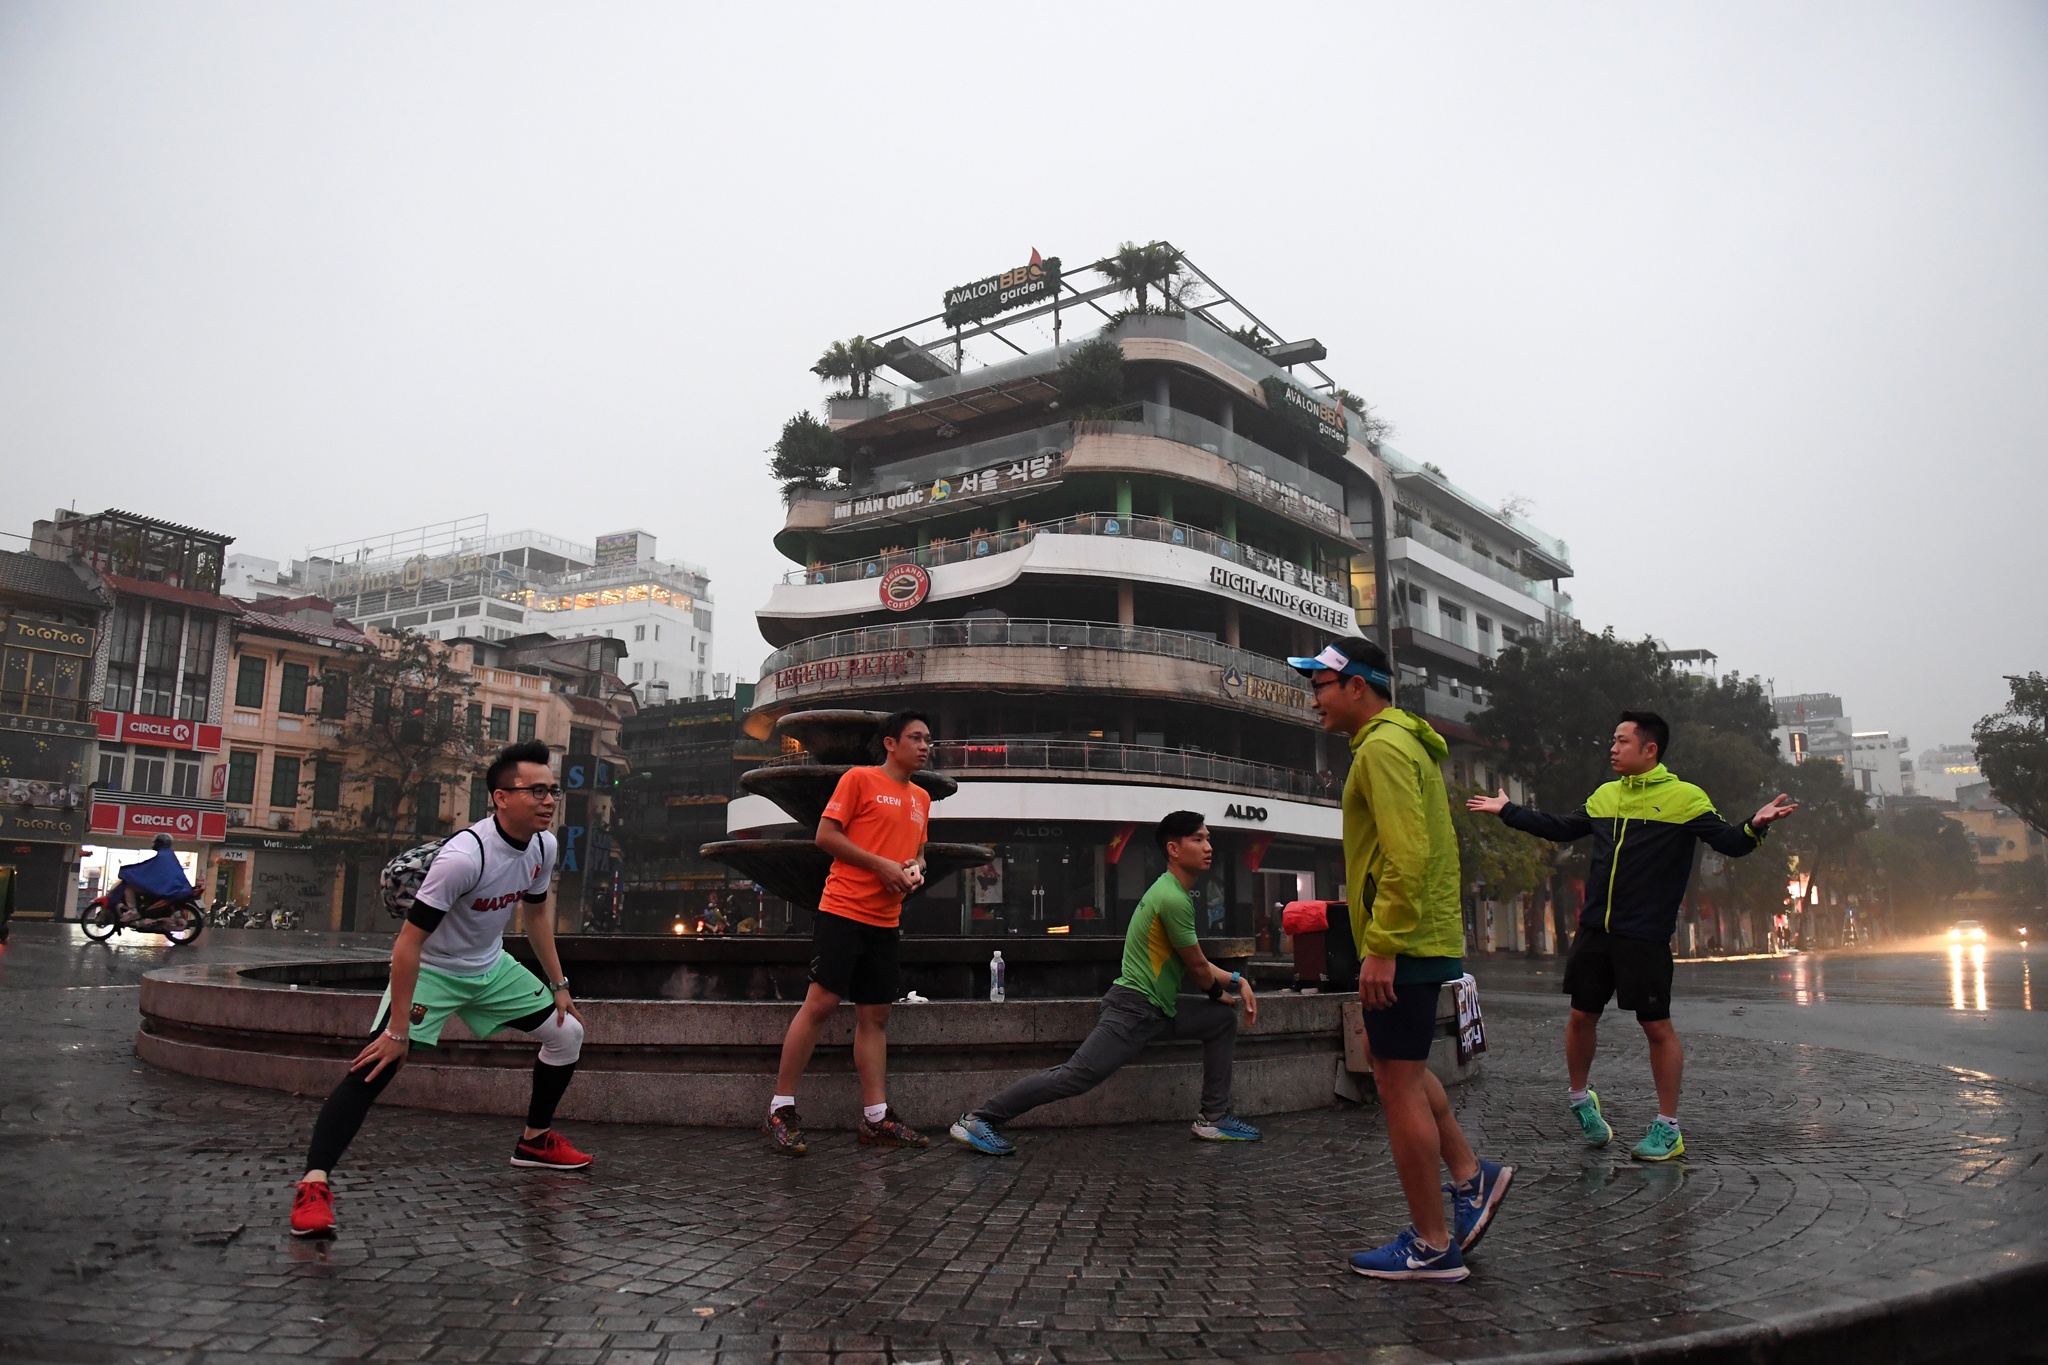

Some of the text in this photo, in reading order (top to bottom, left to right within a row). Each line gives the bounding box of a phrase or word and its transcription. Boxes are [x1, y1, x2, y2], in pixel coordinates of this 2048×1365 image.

[950, 264, 1047, 305] AVALON BBQ
[1000, 281, 1044, 304] garden
[1285, 388, 1319, 417] AVALON
[1319, 423, 1345, 443] garden
[958, 455, 1052, 493] 서울 식당
[881, 567, 925, 589] HIGHLANDS
[1266, 557, 1295, 585] 서울
[1300, 568, 1326, 597] 식당
[887, 594, 920, 609] COFFEE
[1211, 566, 1349, 628] HIGHLANDS COFFEE
[775, 661, 840, 690] LEGEND
[130, 722, 189, 740] CIRCLE K
[877, 795, 901, 806] CREW
[132, 814, 193, 830] CIRCLE K
[1224, 803, 1268, 822] ALDO
[1014, 827, 1063, 837] ALDO
